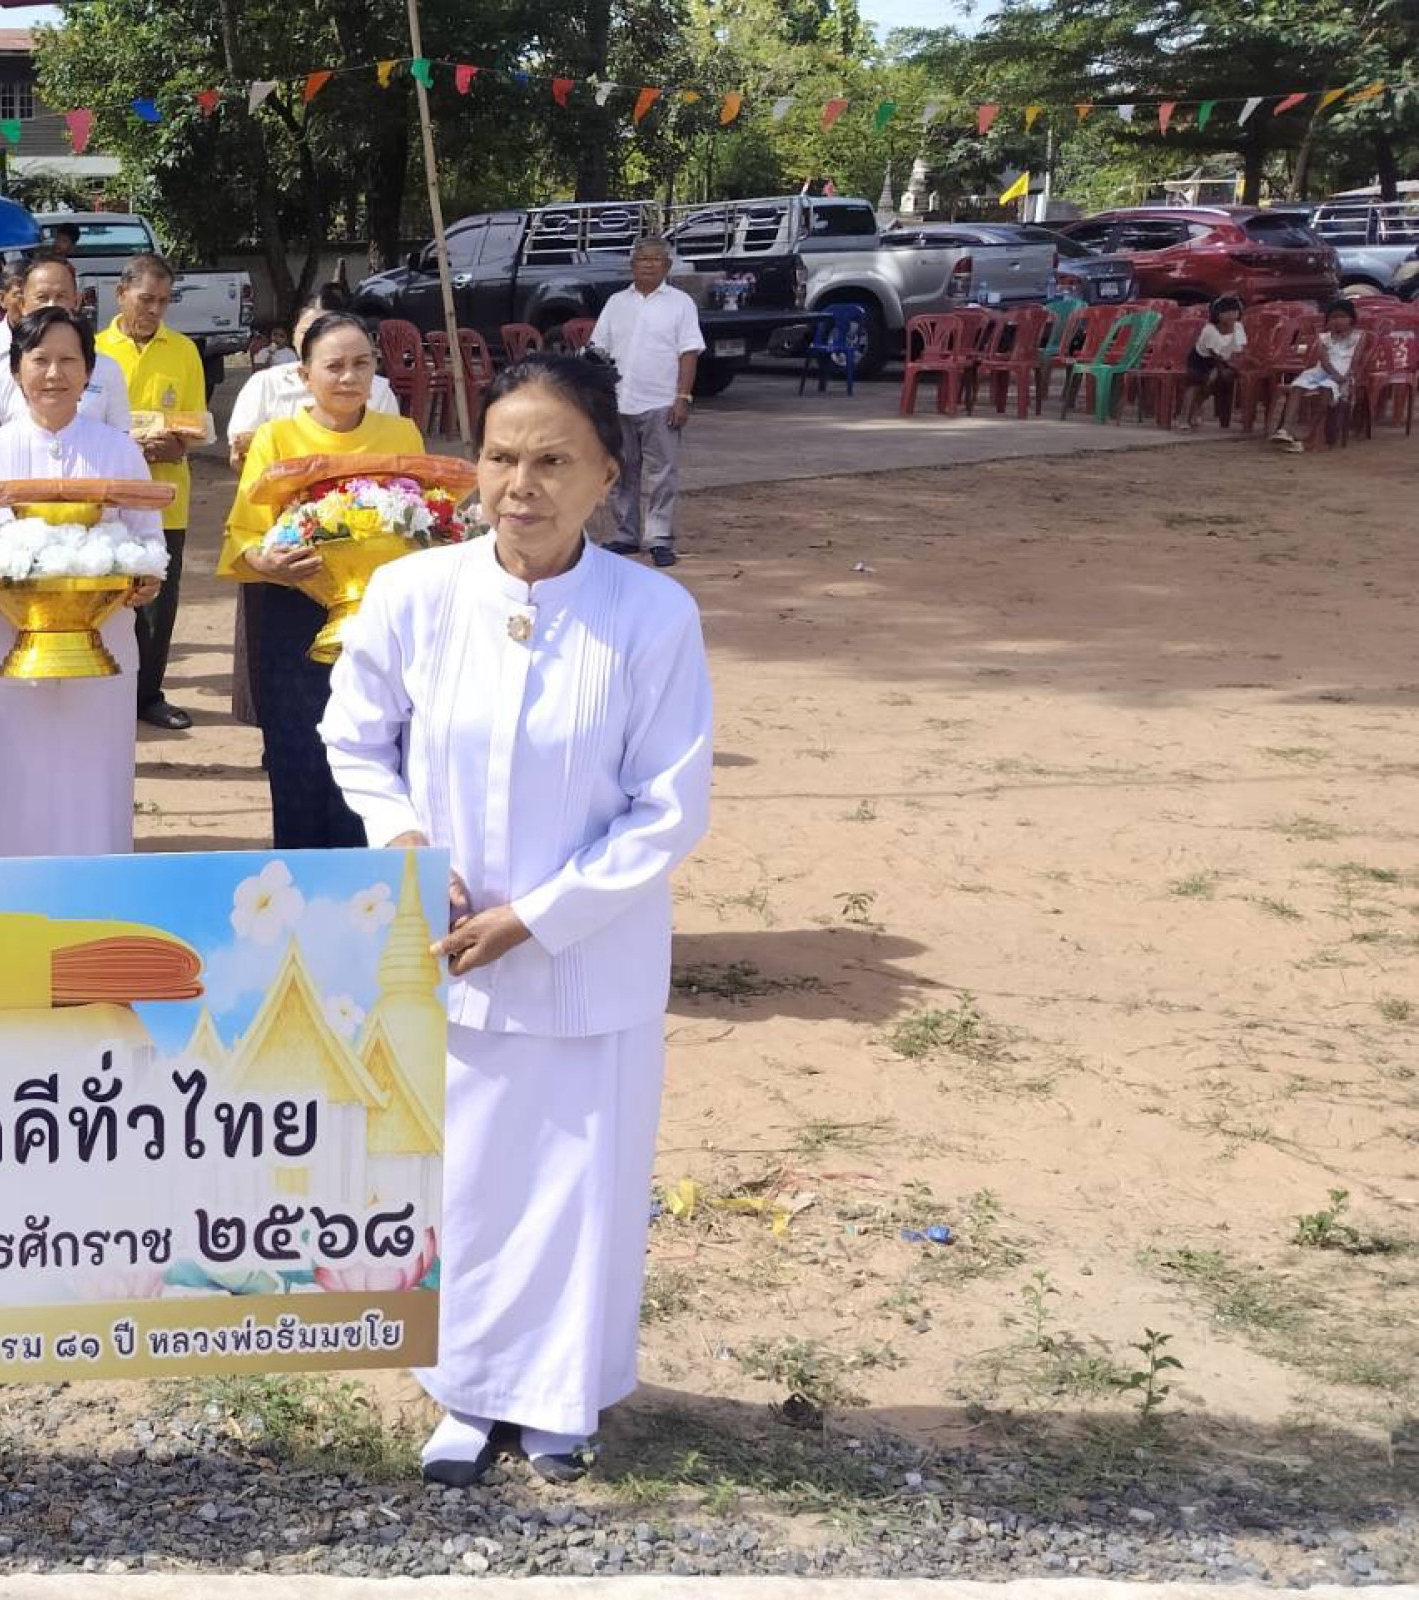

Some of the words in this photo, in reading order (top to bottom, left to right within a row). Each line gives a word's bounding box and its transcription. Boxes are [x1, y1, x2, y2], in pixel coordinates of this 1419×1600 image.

[194, 1202, 415, 1263] ๒๕๖๘
[55, 1334, 101, 1359] ๘๑
[113, 1320, 134, 1356] ปี
[149, 1313, 401, 1355] หลวงพ่อธัมมชโย
